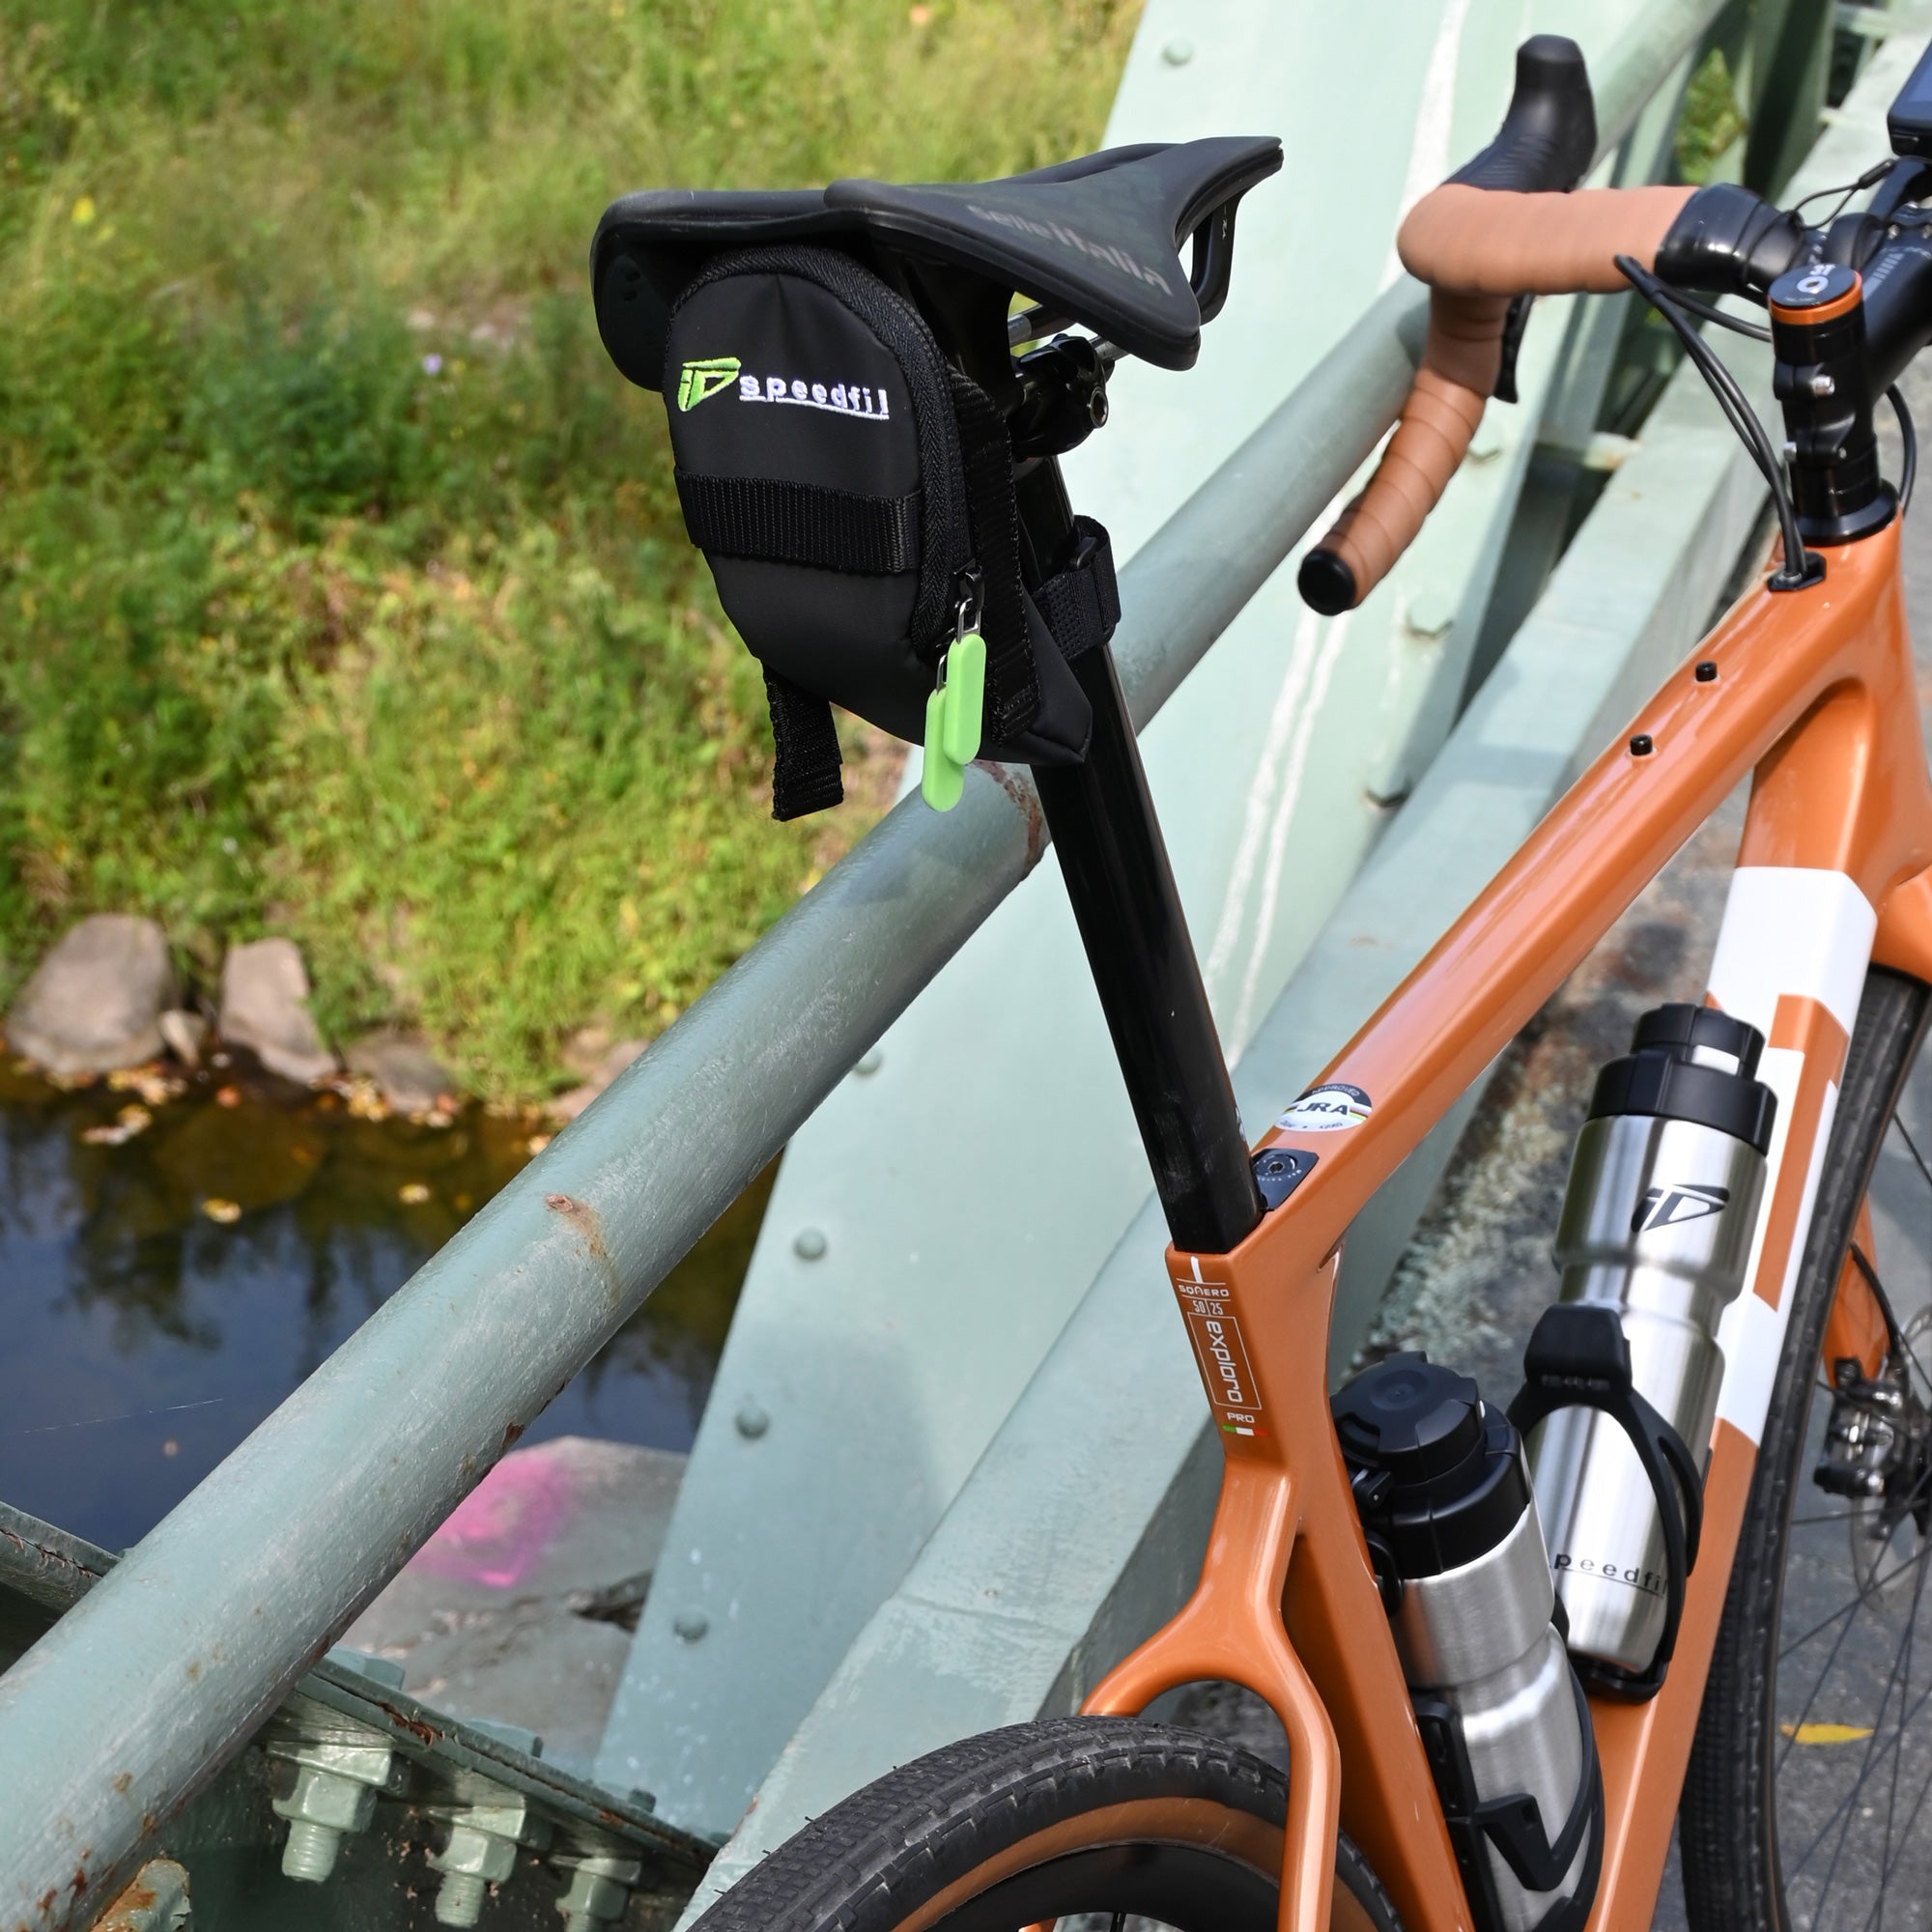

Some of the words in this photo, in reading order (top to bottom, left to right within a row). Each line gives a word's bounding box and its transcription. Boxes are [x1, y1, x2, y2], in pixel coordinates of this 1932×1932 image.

[739, 374, 889, 416] speedfil
[1296, 1101, 1350, 1117] JRA
[1192, 1299, 1207, 1314] 50
[1209, 1301, 1224, 1316] 25
[1206, 1320, 1244, 1404] exploro
[1226, 1410, 1256, 1425] PRO
[1549, 1552, 1668, 1596] peedfil
